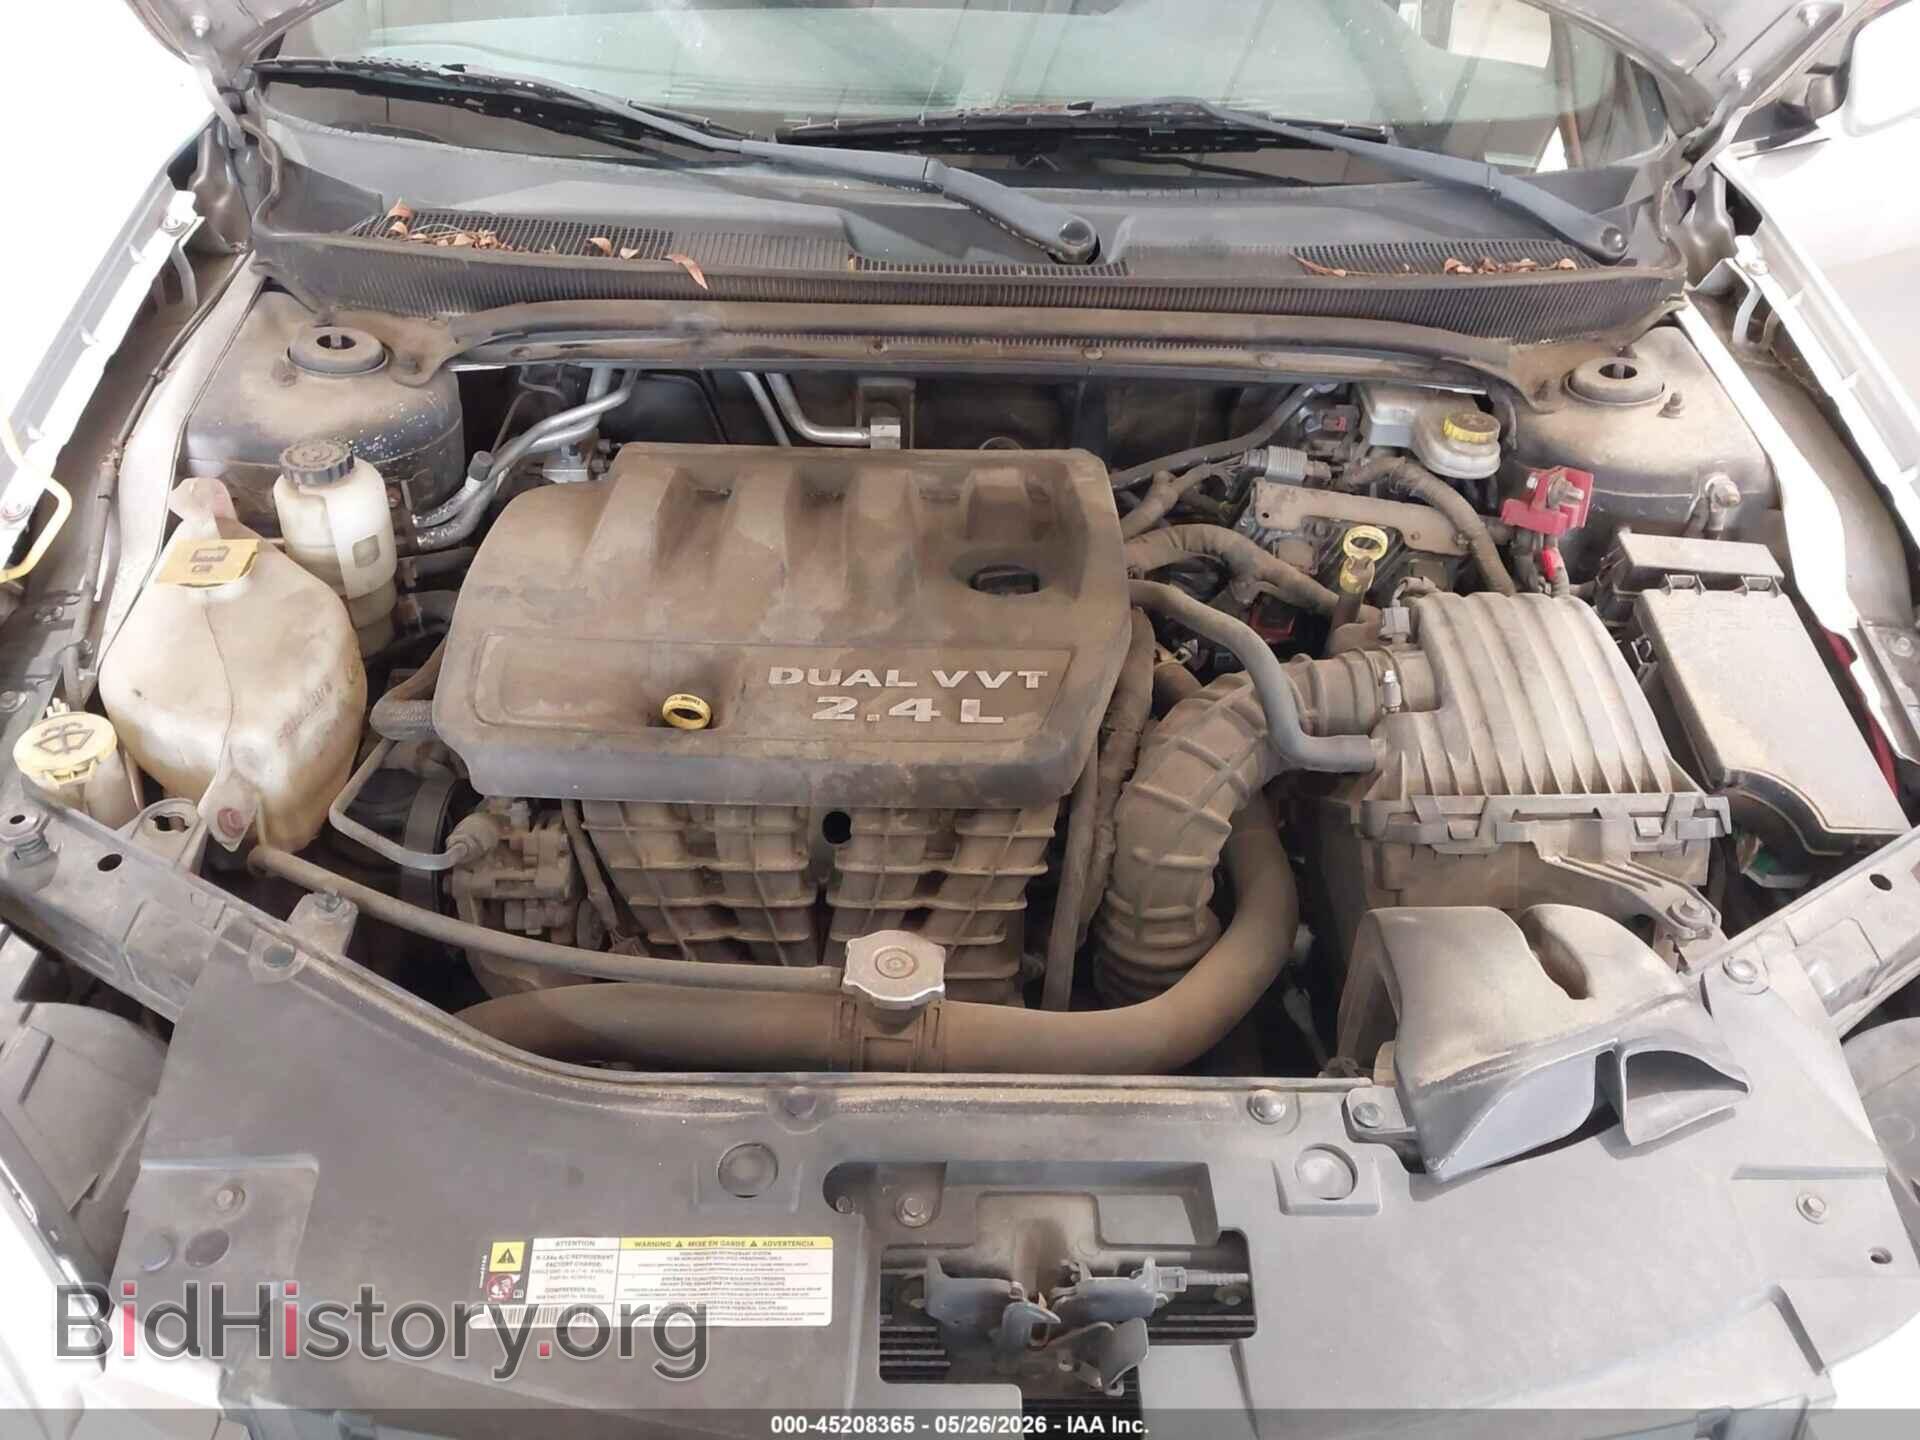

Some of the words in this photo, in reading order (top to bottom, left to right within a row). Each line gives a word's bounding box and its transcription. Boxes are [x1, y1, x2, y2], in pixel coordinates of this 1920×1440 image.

[768, 667, 918, 687] DUAL
[932, 670, 1049, 689] VVT
[812, 696, 942, 722] 2.4
[960, 698, 1005, 723] L
